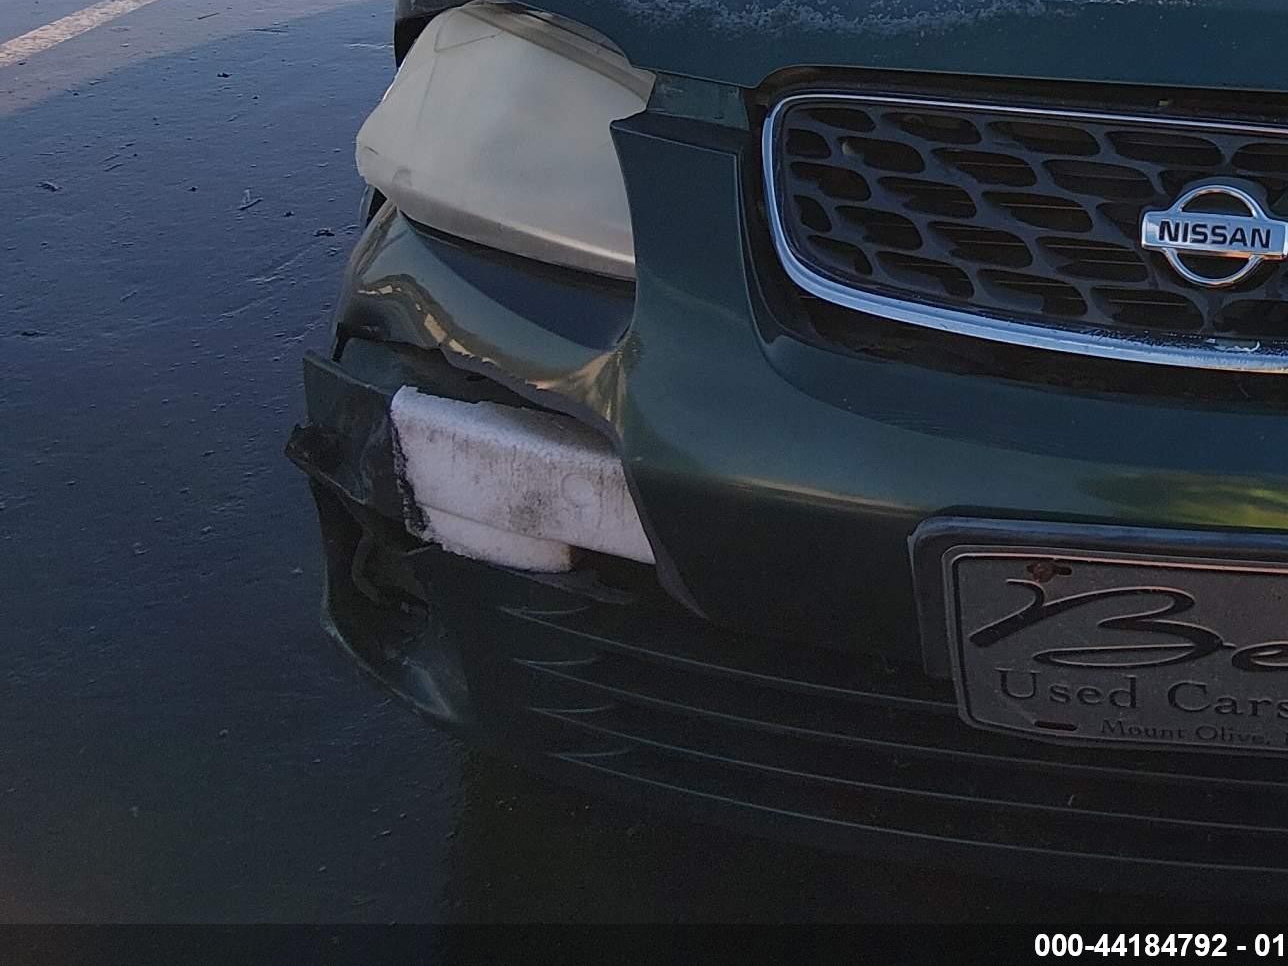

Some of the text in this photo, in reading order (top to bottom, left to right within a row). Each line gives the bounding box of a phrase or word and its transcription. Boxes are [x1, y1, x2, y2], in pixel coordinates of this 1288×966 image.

[1159, 221, 1271, 249] NISSAN
[996, 667, 1138, 709] Used
[1101, 719, 1185, 740] Mount
